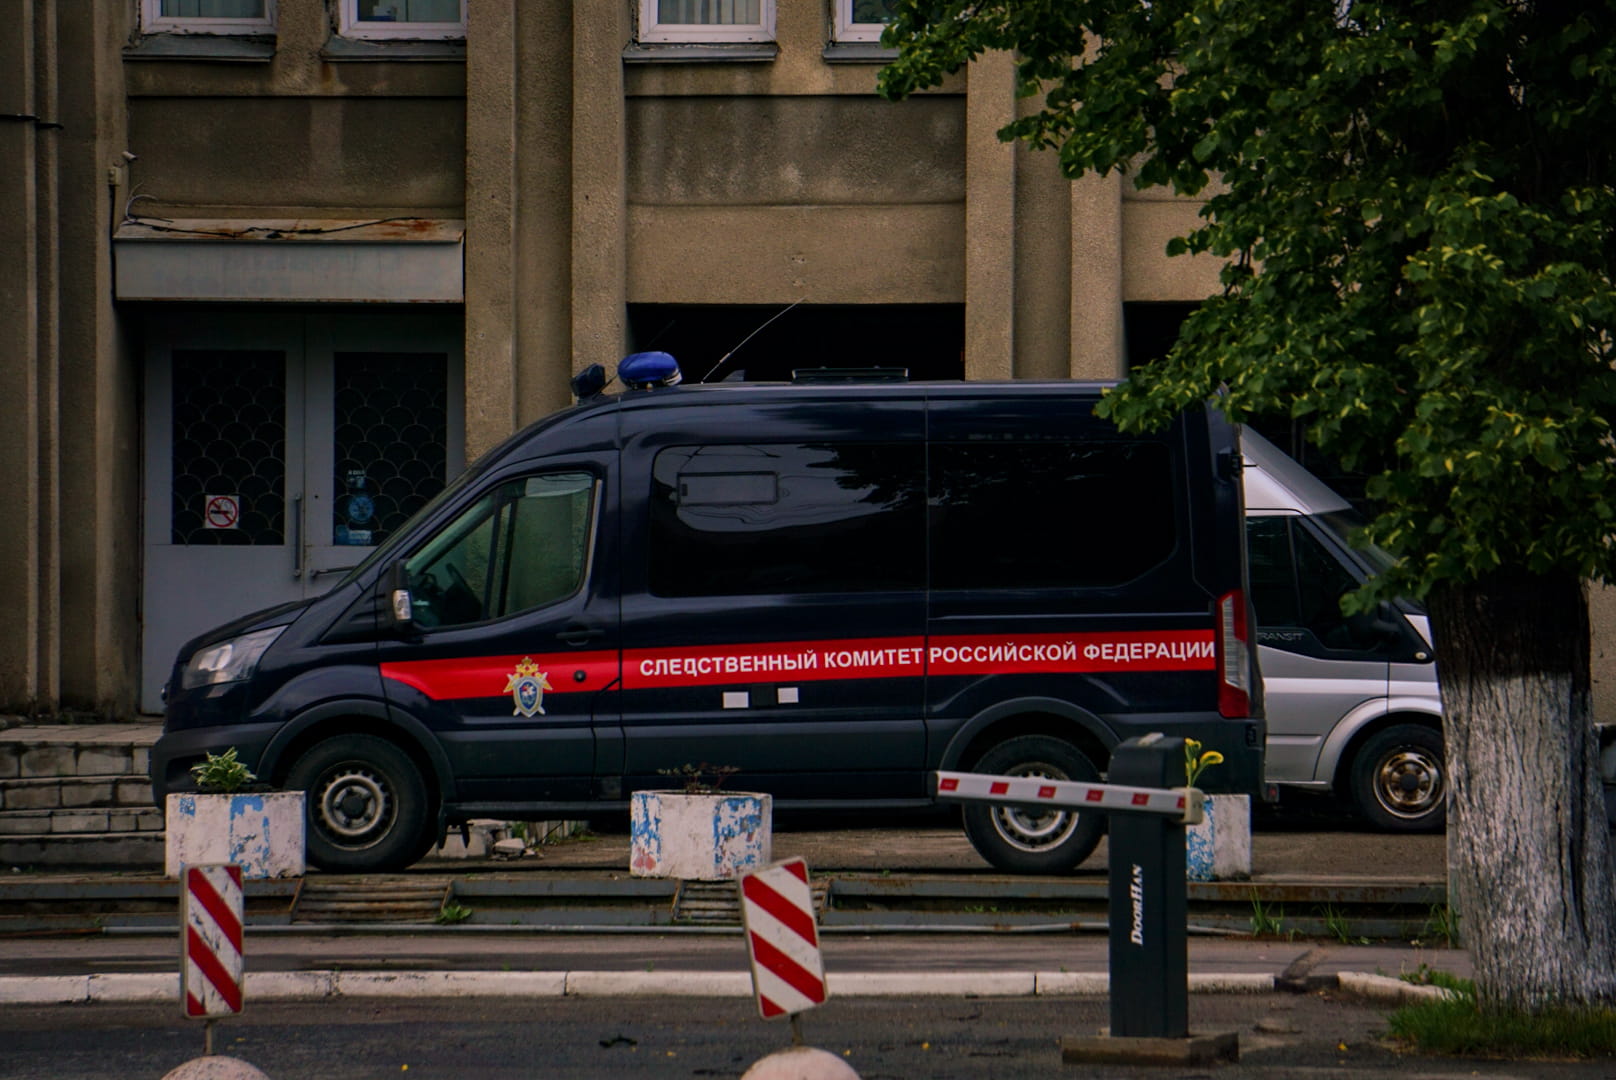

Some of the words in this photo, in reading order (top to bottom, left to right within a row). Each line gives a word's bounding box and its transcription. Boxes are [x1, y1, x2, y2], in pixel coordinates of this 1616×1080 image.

[640, 649, 818, 677] СЛЕДСТВЕННЫЙ
[824, 643, 923, 668] КОМИТЕТ
[929, 641, 1077, 663] РОССИЙСКОЙ
[1083, 641, 1215, 662] ФЕДЕРАЦИИ
